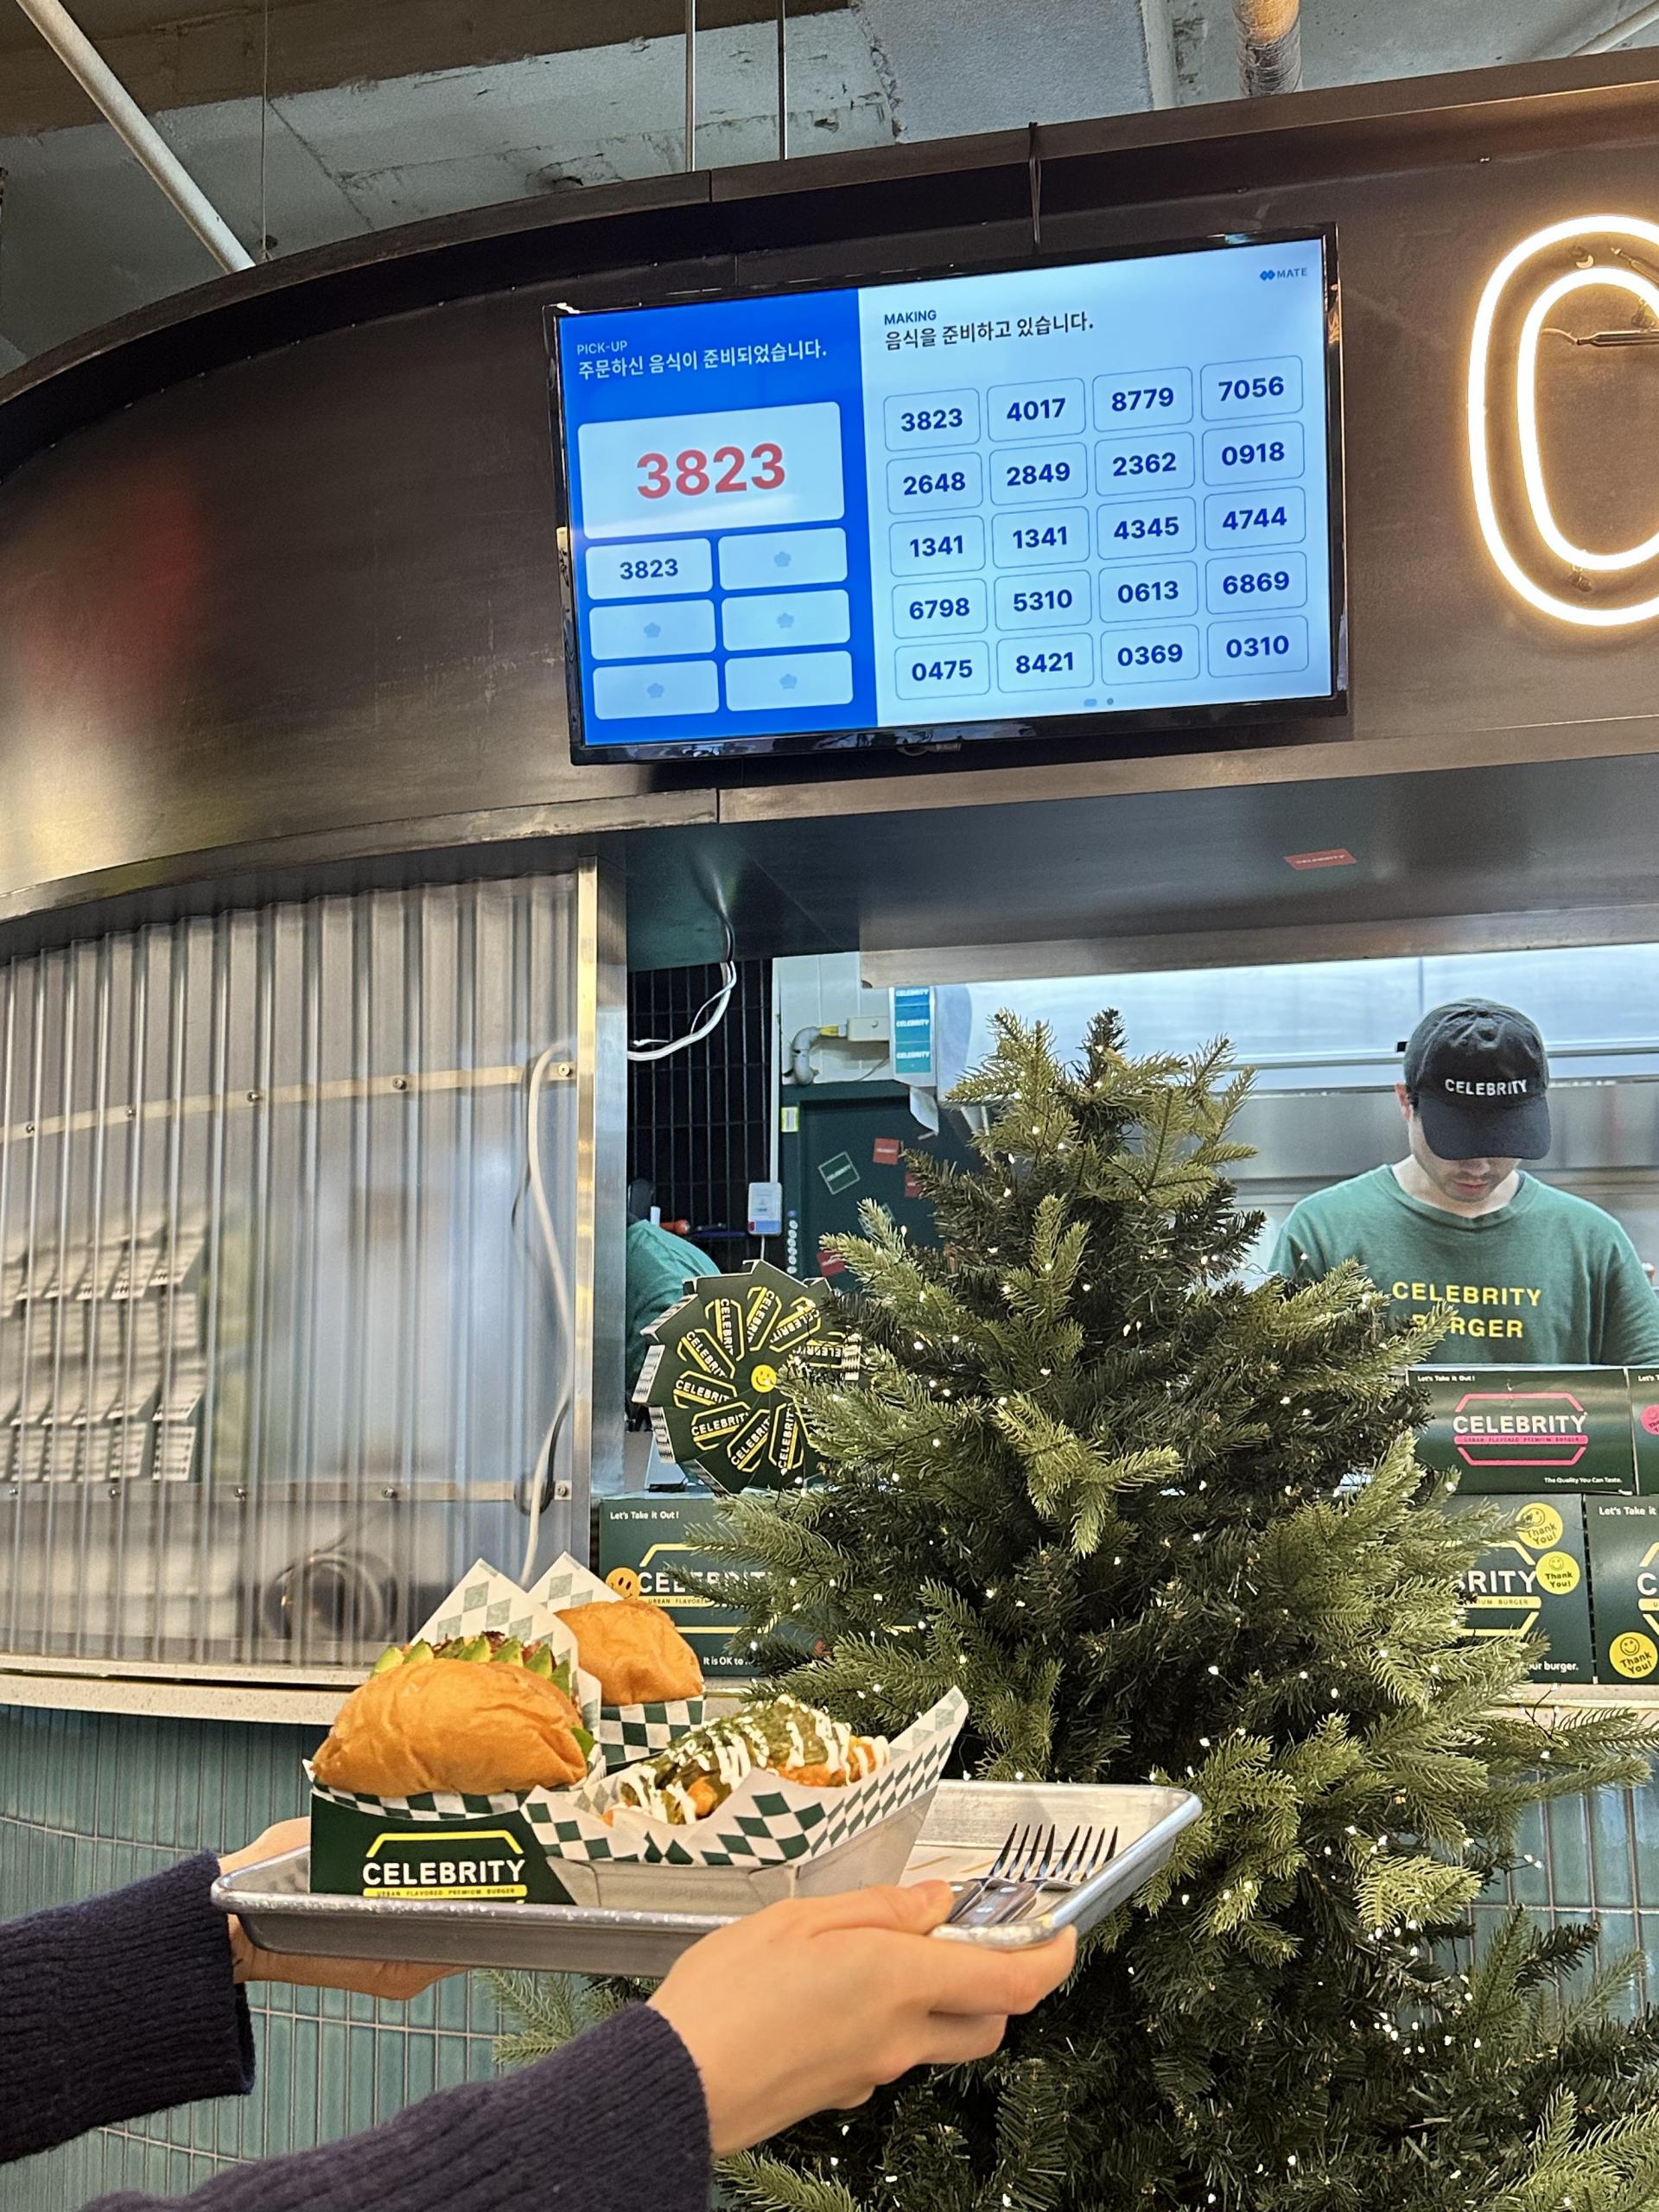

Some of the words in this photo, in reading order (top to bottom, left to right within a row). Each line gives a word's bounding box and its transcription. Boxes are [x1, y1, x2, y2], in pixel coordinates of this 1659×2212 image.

[1277, 267, 1307, 278] MATE
[884, 309, 937, 325] MAKING
[885, 326, 937, 351] 음식을
[942, 321, 1012, 345] 준비하고
[1016, 311, 1094, 338] 있습니다.
[576, 340, 627, 355] PICK-UP
[578, 357, 644, 380] 주문하신
[648, 351, 698, 374] 음식이
[702, 338, 827, 369] 준비되었습니다.
[1111, 387, 1174, 411] 8779
[1218, 377, 1284, 401] 7056
[900, 409, 963, 431] 3823
[1006, 398, 1066, 422] 4017
[1112, 453, 1177, 476] 2362
[1221, 442, 1286, 466] 0918
[637, 443, 785, 499] 3823
[1006, 462, 1071, 486] 2849
[903, 472, 966, 495] 2648
[1114, 517, 1179, 539] 4345
[1223, 507, 1287, 530] 4744
[910, 536, 964, 557] 1341
[1013, 526, 1068, 549] 1341
[620, 558, 678, 580] 3823
[1117, 581, 1179, 603] 0613
[1223, 572, 1290, 594] 6869
[909, 597, 969, 620] 6798
[1014, 589, 1072, 612] 5310
[1117, 644, 1183, 665] 0369
[1226, 636, 1289, 658] 0310
[912, 659, 973, 681] 0475
[1015, 652, 1074, 674] 8421
[1445, 1078, 1527, 1096] CELEBRITY
[1392, 1281, 1541, 1306] CELEBRITY
[1412, 1314, 1523, 1338] BRGER
[1452, 1414, 1586, 1434] CELEBRITY
[610, 1511, 628, 1520] Let's
[631, 1511, 649, 1520] Take
[1599, 1506, 1622, 1516] Let's
[1624, 1506, 1646, 1515] Take
[1648, 1505, 1656, 1515] it
[1527, 1522, 1557, 1538] Thank
[1545, 1571, 1573, 1580] Thank
[703, 1656, 710, 1665] It
[711, 1656, 718, 1665] is
[720, 1656, 734, 1665] OK
[1543, 1661, 1580, 1673] burger.
[1620, 1651, 1652, 1669] Thank
[1628, 1661, 1652, 1675] You!
[362, 1859, 524, 1885] CELEBRITY
